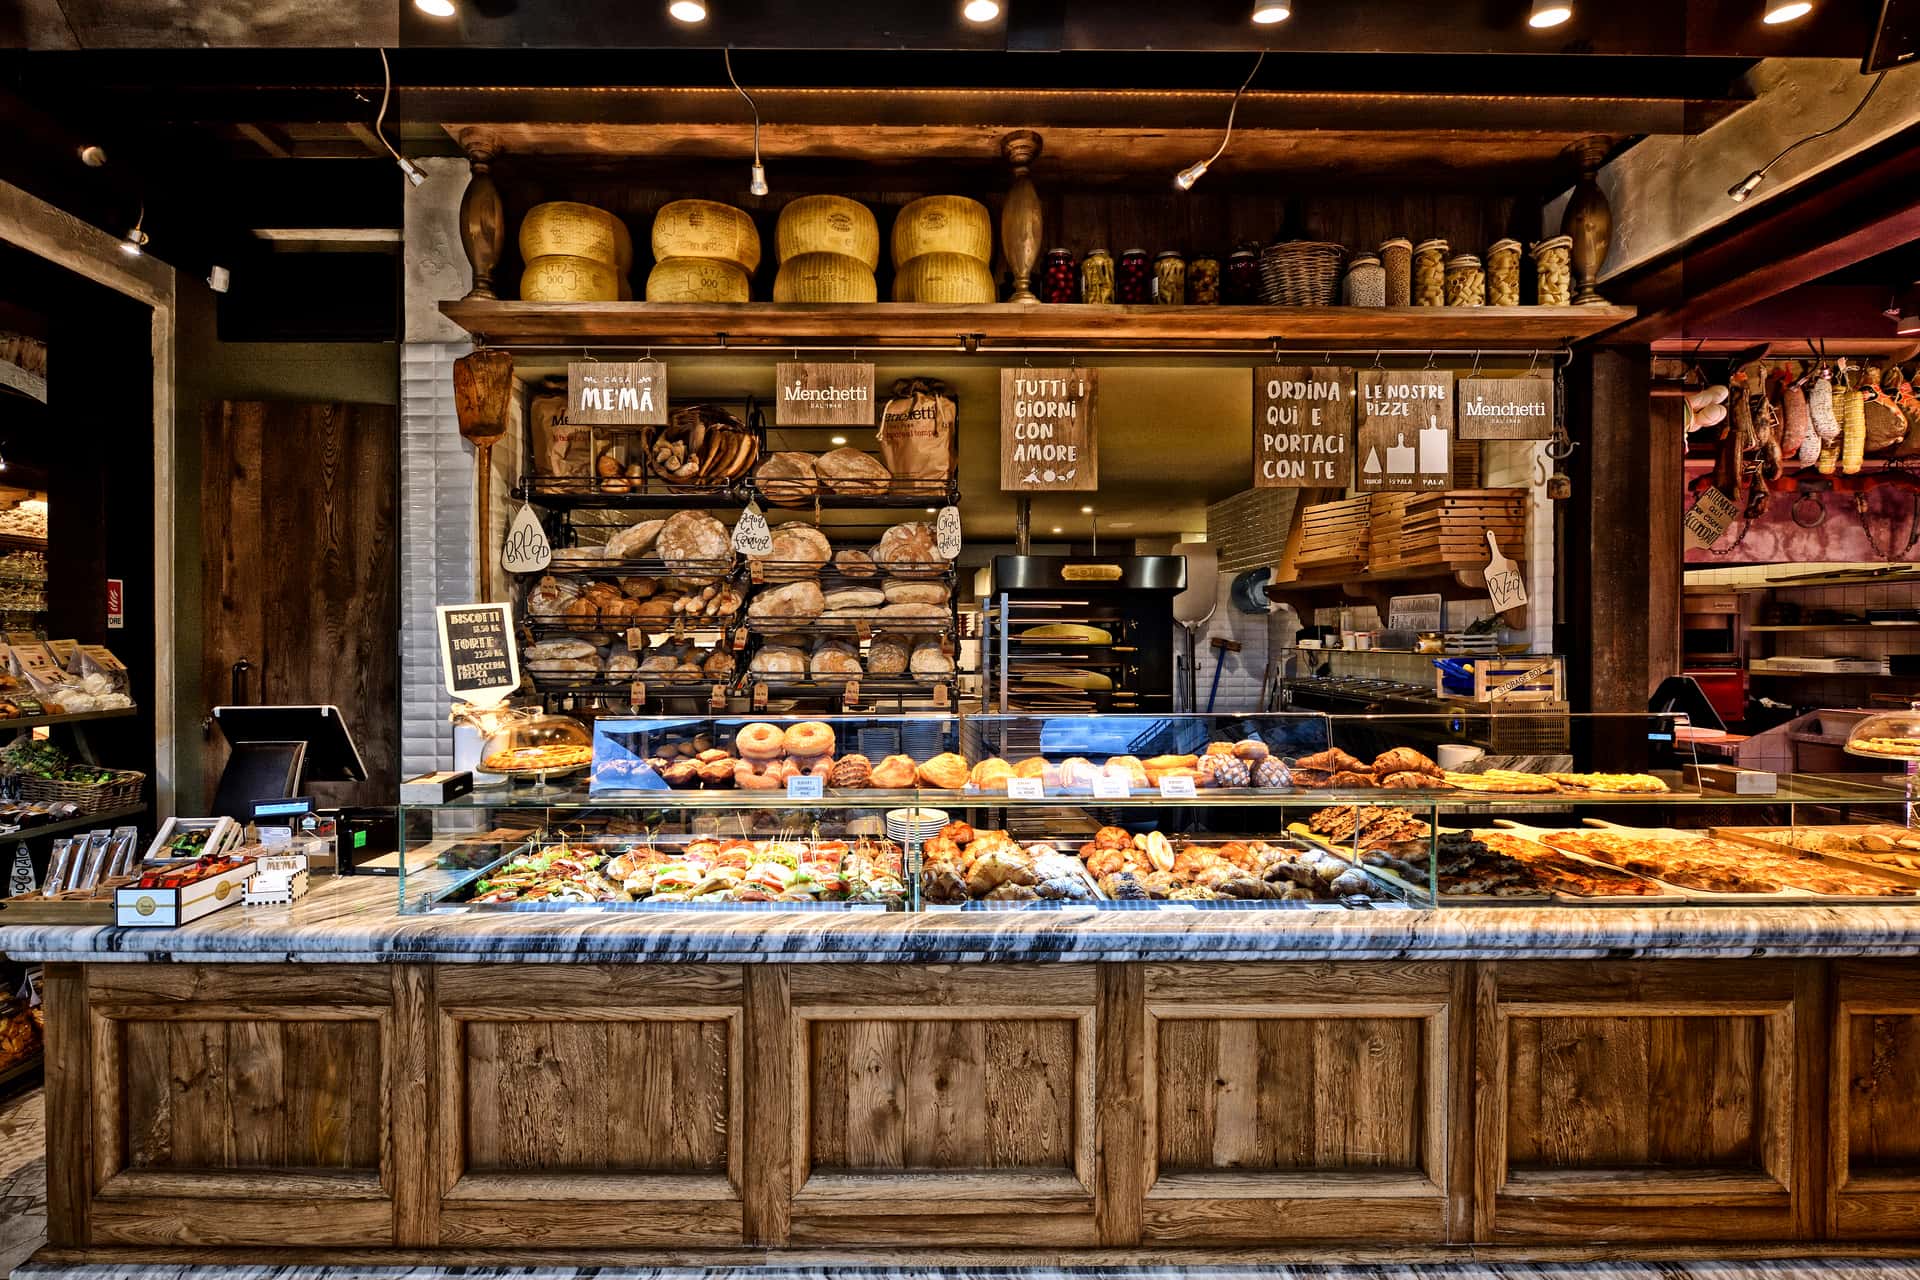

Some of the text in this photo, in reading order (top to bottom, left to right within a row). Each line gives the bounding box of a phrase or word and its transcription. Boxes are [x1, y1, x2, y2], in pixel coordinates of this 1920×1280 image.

[784, 380, 867, 401] Menchetti
[1365, 384, 1446, 400] LE NOSTRE
[1466, 396, 1546, 416] Menchetti
[1312, 408, 1321, 426] E
[1014, 423, 1054, 440] CON
[1013, 444, 1077, 462] AMORE
[1263, 460, 1335, 479] CON TE
[450, 611, 499, 624] BISCOTTI
[452, 637, 494, 650] TORTE
[457, 661, 506, 672] PASTICCERIA
[458, 671, 488, 680] FRESCA
[1498, 667, 1543, 693] STORAGE BOX
